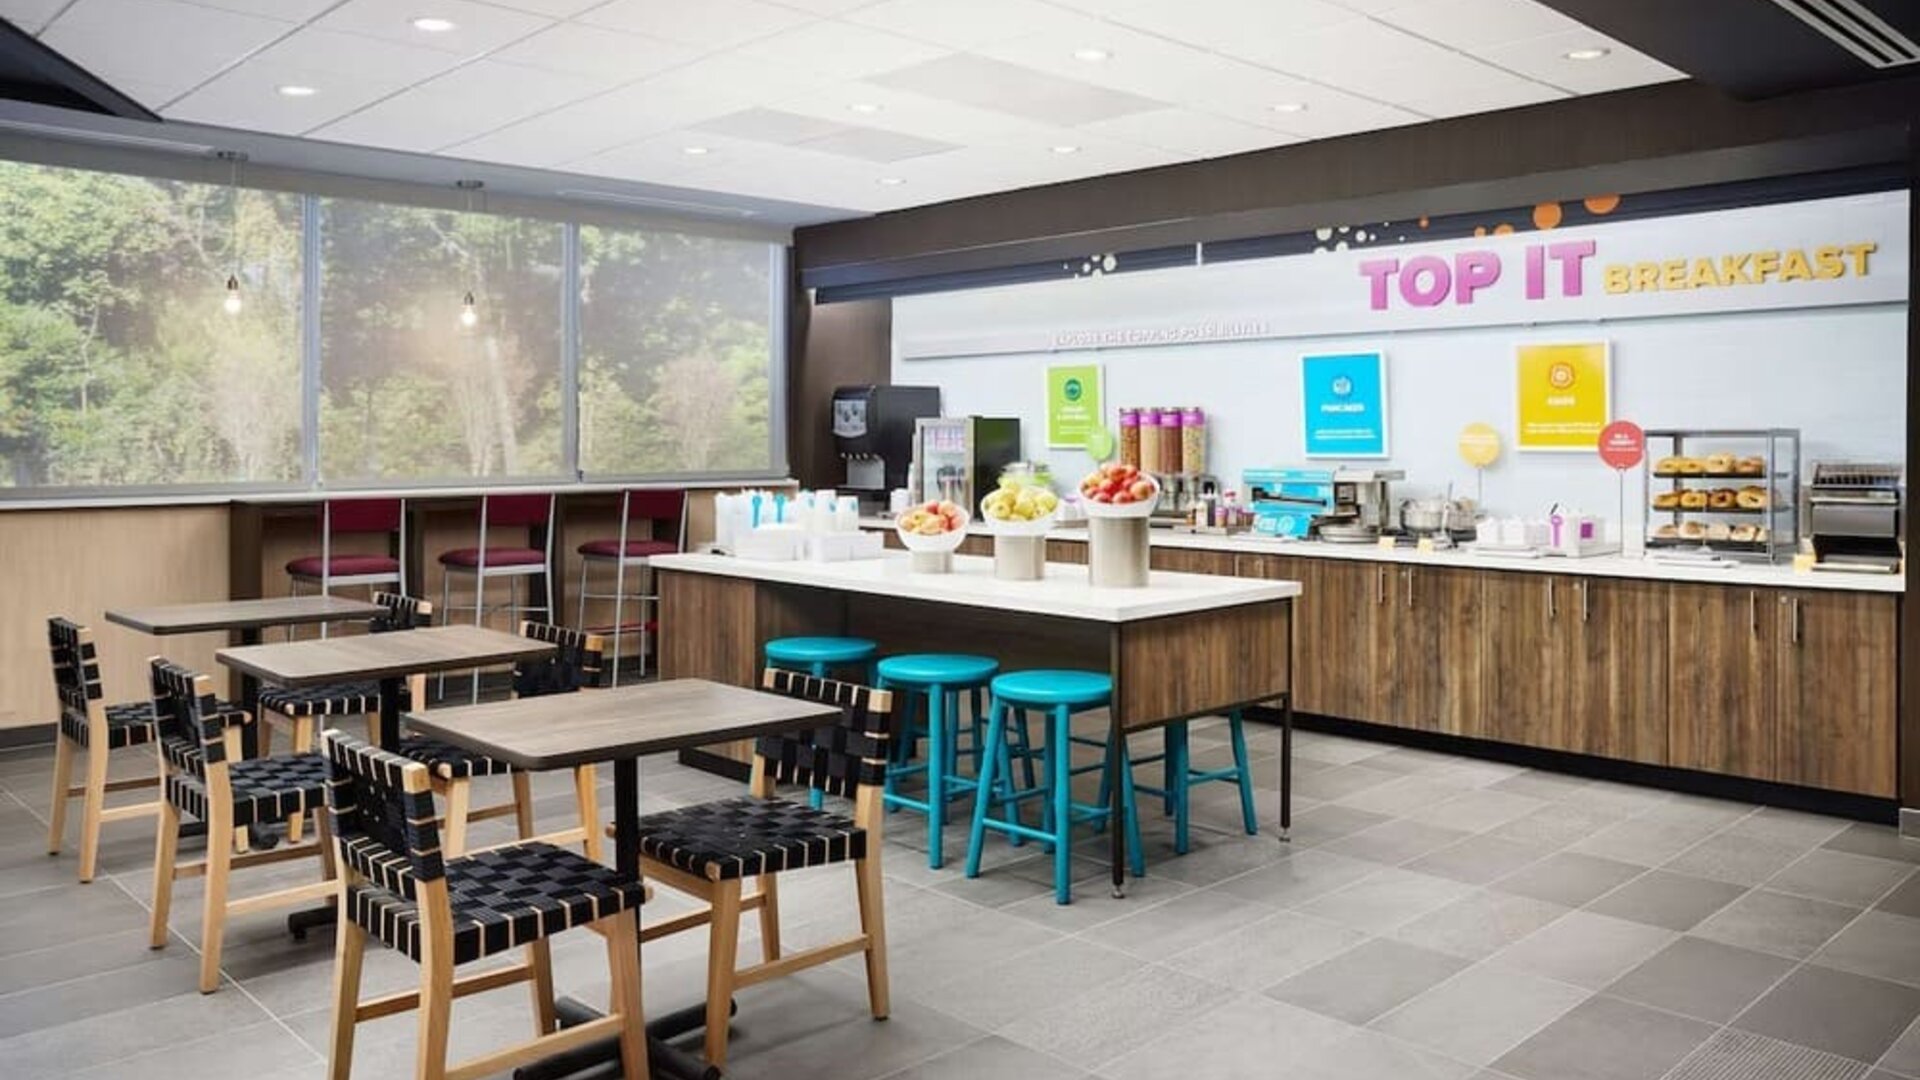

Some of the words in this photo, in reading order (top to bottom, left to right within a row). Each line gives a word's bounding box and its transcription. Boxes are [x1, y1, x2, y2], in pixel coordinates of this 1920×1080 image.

[1359, 250, 1501, 310] TOP
[1525, 240, 1596, 300] IT
[1604, 242, 1877, 294] BREAKFAST
